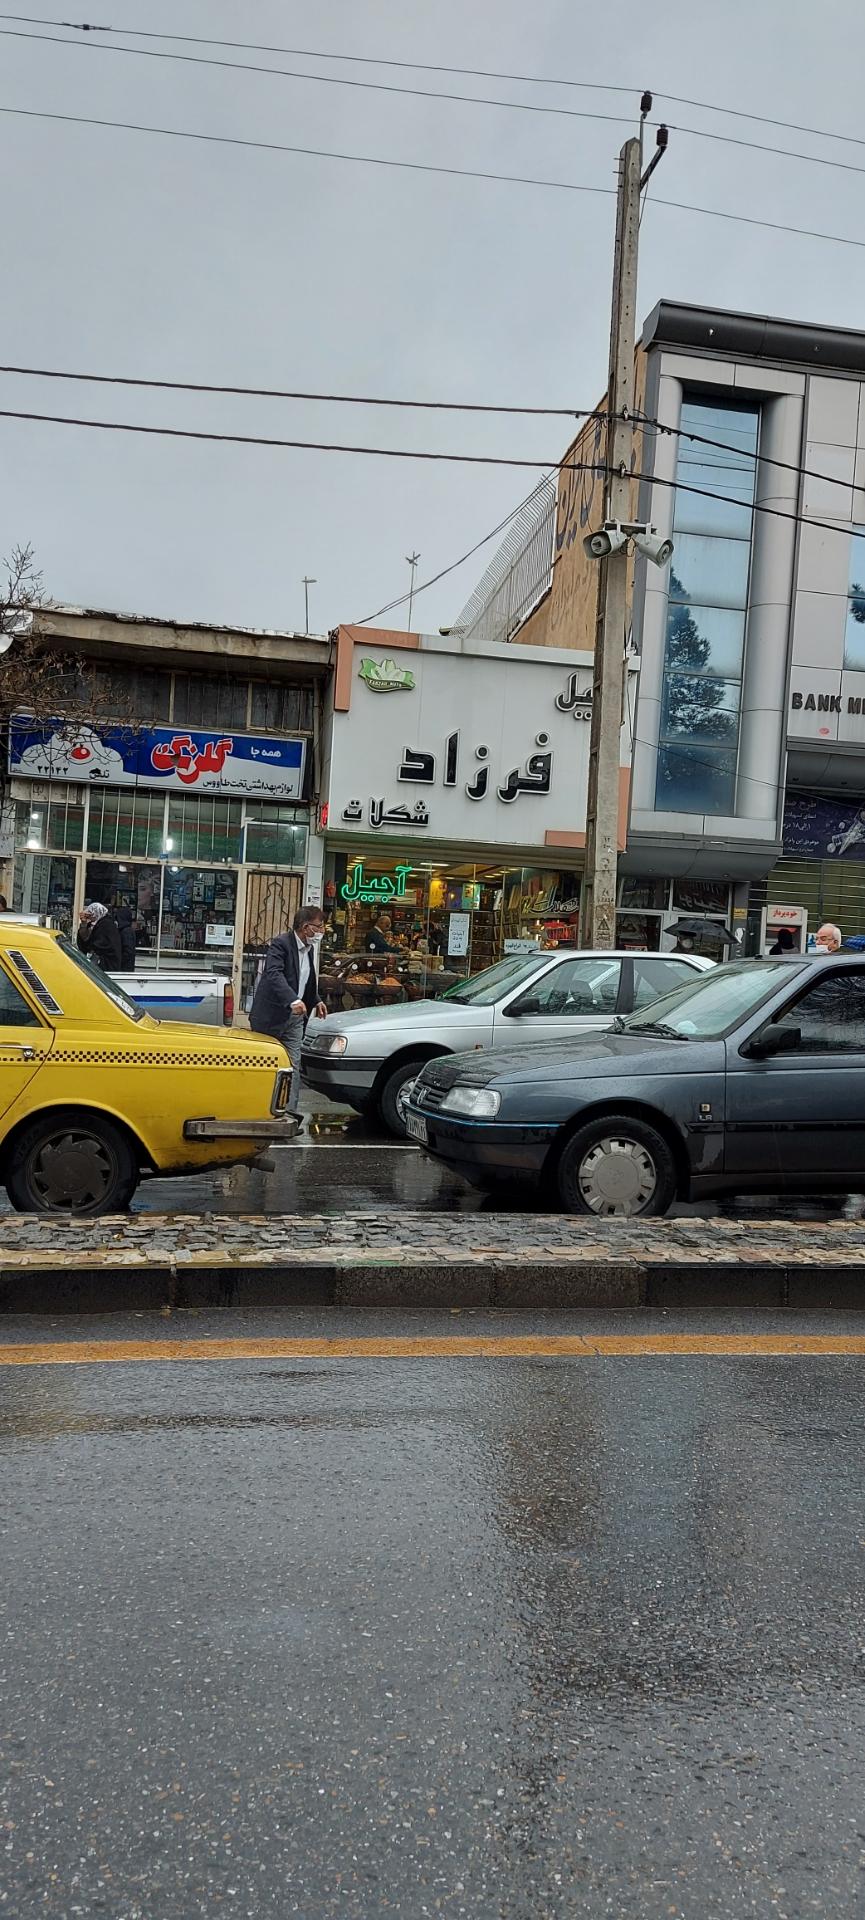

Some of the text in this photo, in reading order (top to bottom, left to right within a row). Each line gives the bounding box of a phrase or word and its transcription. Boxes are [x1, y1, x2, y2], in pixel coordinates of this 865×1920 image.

[792, 692, 842, 713] BANK
[151, 735, 234, 785] گلرنگ
[250, 746, 282, 759] همه جا
[397, 728, 555, 803] فرزاد
[88, 767, 110, 780] تلن
[342, 796, 430, 829] شکلات
[341, 864, 413, 905] آجیل
